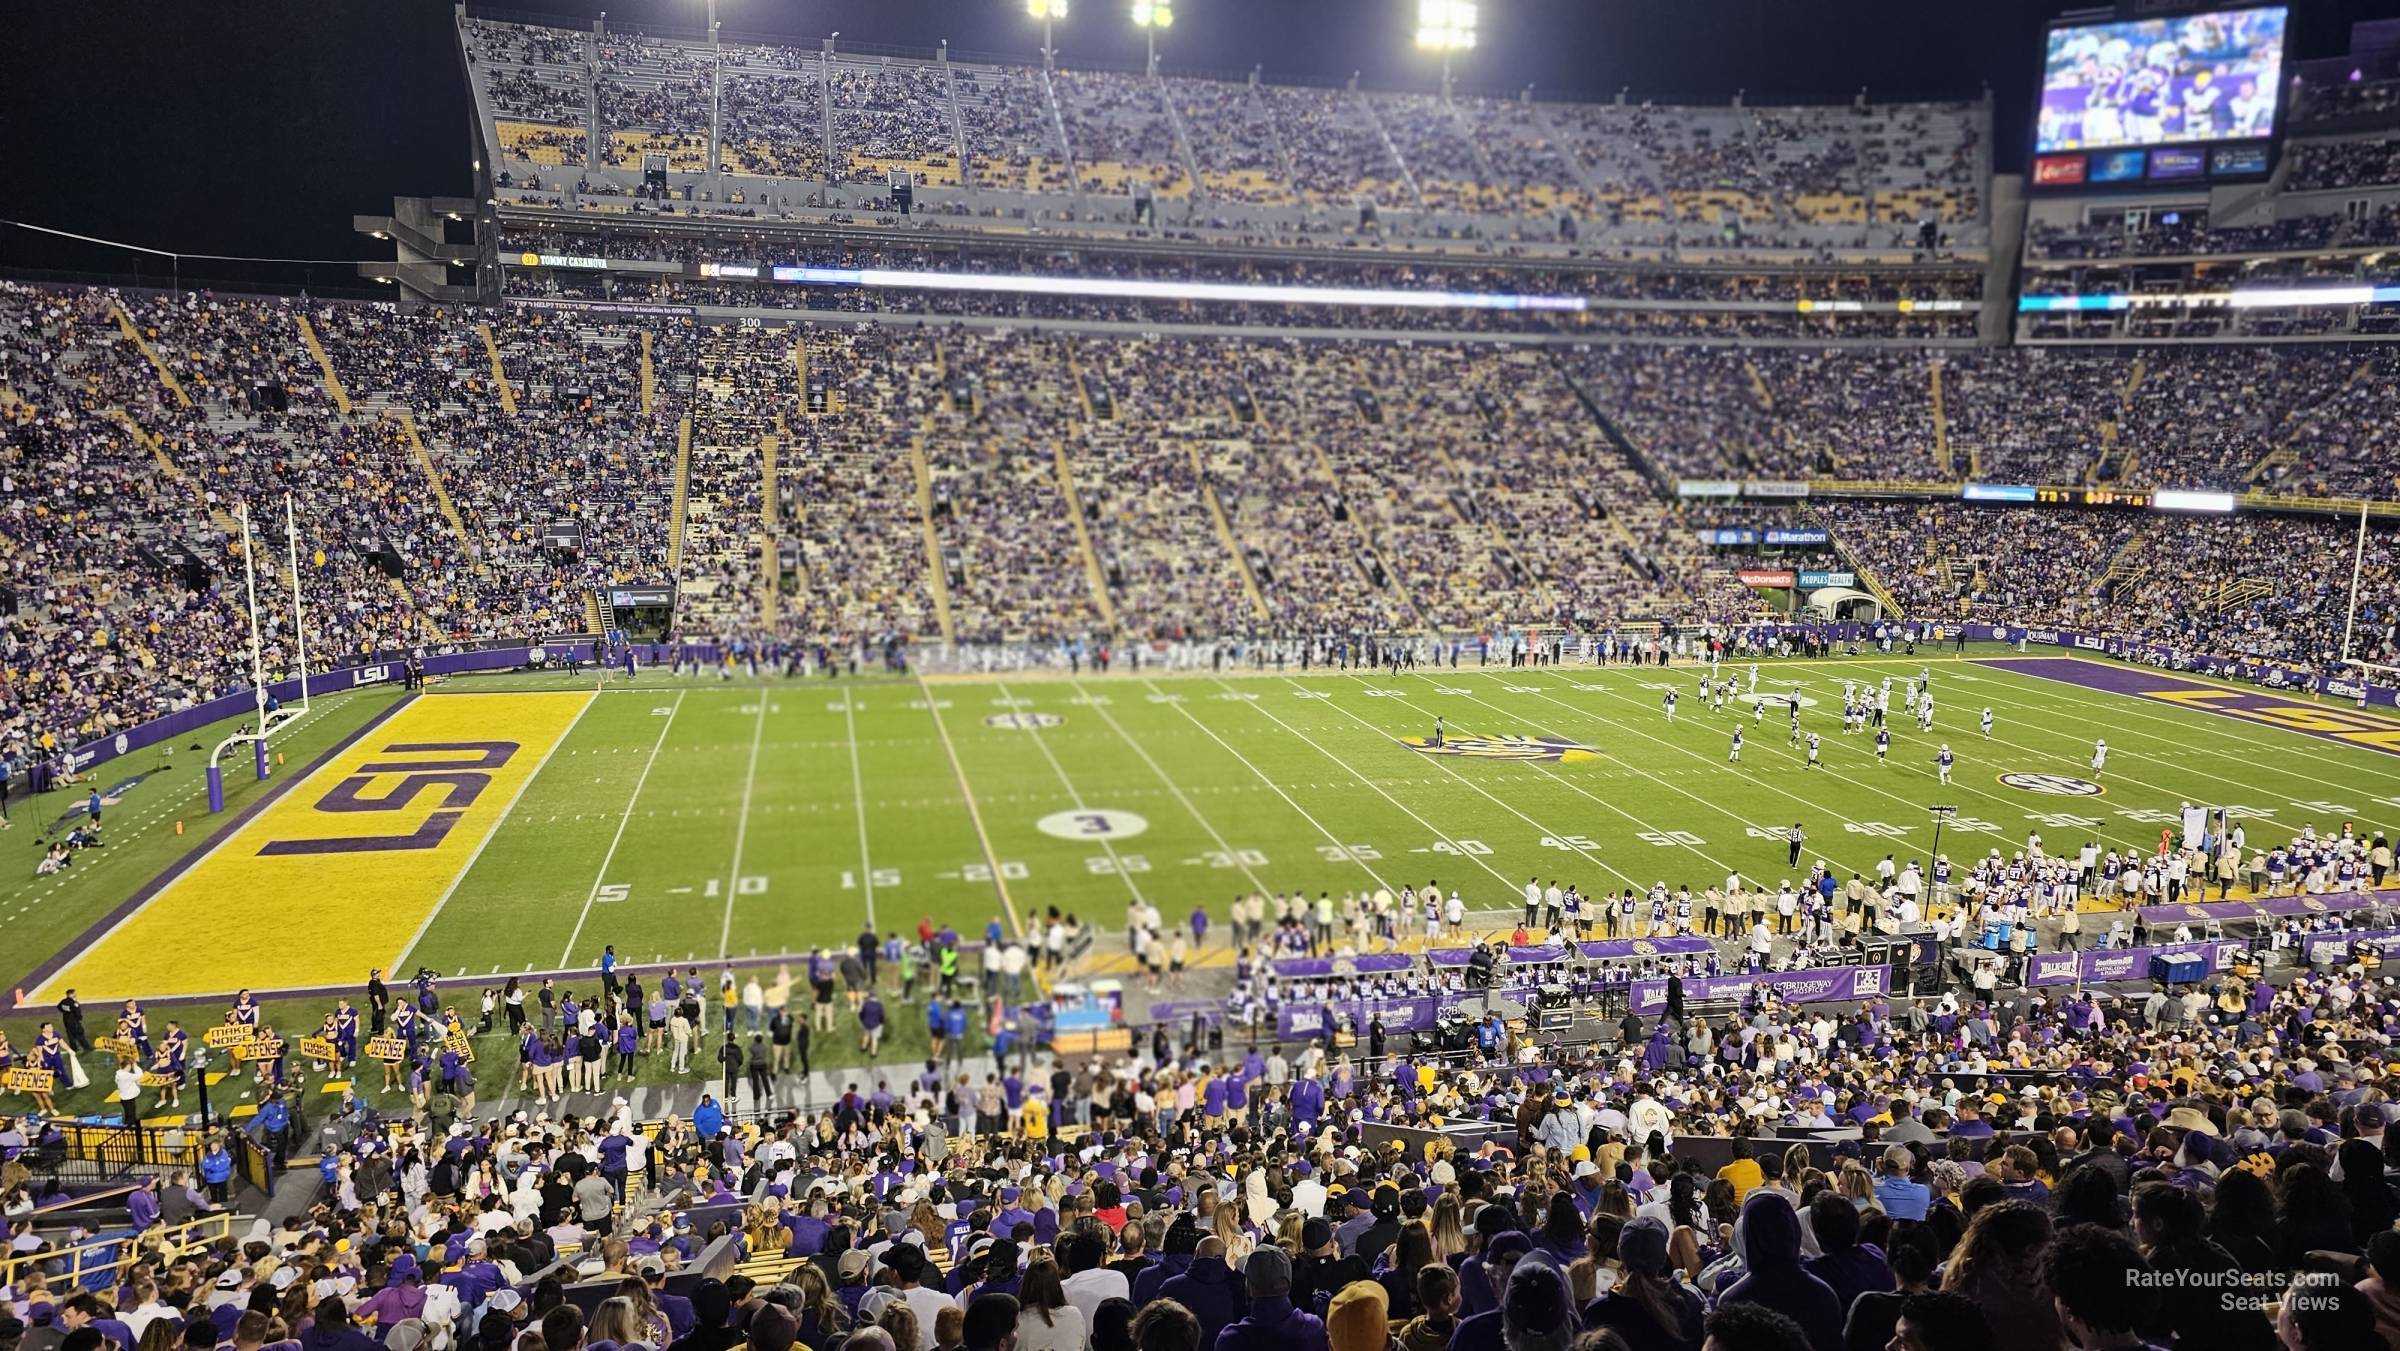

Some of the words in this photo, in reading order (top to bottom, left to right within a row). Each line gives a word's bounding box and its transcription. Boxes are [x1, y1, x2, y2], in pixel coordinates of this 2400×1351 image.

[540, 255, 567, 266] TOMMY
[569, 257, 607, 269] CASANOVA
[740, 318, 760, 327] 300
[1780, 531, 1826, 542] Marathon
[1741, 575, 1791, 584] McDonald's
[1801, 575, 1827, 584] PEOPLES
[1830, 574, 1852, 584] HEALTH
[2075, 635, 2105, 650] LSU
[354, 665, 388, 685] LSU
[256, 741, 521, 857] LSU
[1074, 815, 1112, 834] 3
[1540, 835, 1603, 851] 45
[1636, 830, 1707, 847] 50
[1316, 844, 1384, 862] 35
[1432, 839, 1495, 856] 40
[1084, 855, 1152, 875] 25
[1202, 848, 1270, 868] 30
[840, 868, 902, 890] 15
[962, 861, 1030, 882] 20
[596, 884, 632, 902] 5
[704, 875, 769, 897] 10
[1680, 905, 1690, 915] 45
[2040, 959, 2077, 974] WALK-ON'S
[2095, 955, 2134, 967] SouthernAIR
[1606, 970, 1614, 982] 14
[1785, 979, 1833, 991] BRIDGEWAY
[1793, 986, 1825, 994] HOSPICE
[211, 1025, 251, 1037] MAKE
[212, 1034, 251, 1046] NOISE
[303, 1041, 332, 1052] MAKE
[454, 1032, 473, 1061] NOISE
[243, 1039, 282, 1058] DEFENSE
[303, 1047, 333, 1058] NOISE
[371, 1039, 404, 1058] DEFENSE
[10, 1069, 51, 1089] DEFENSE
[954, 1225, 971, 1234] KELLY
